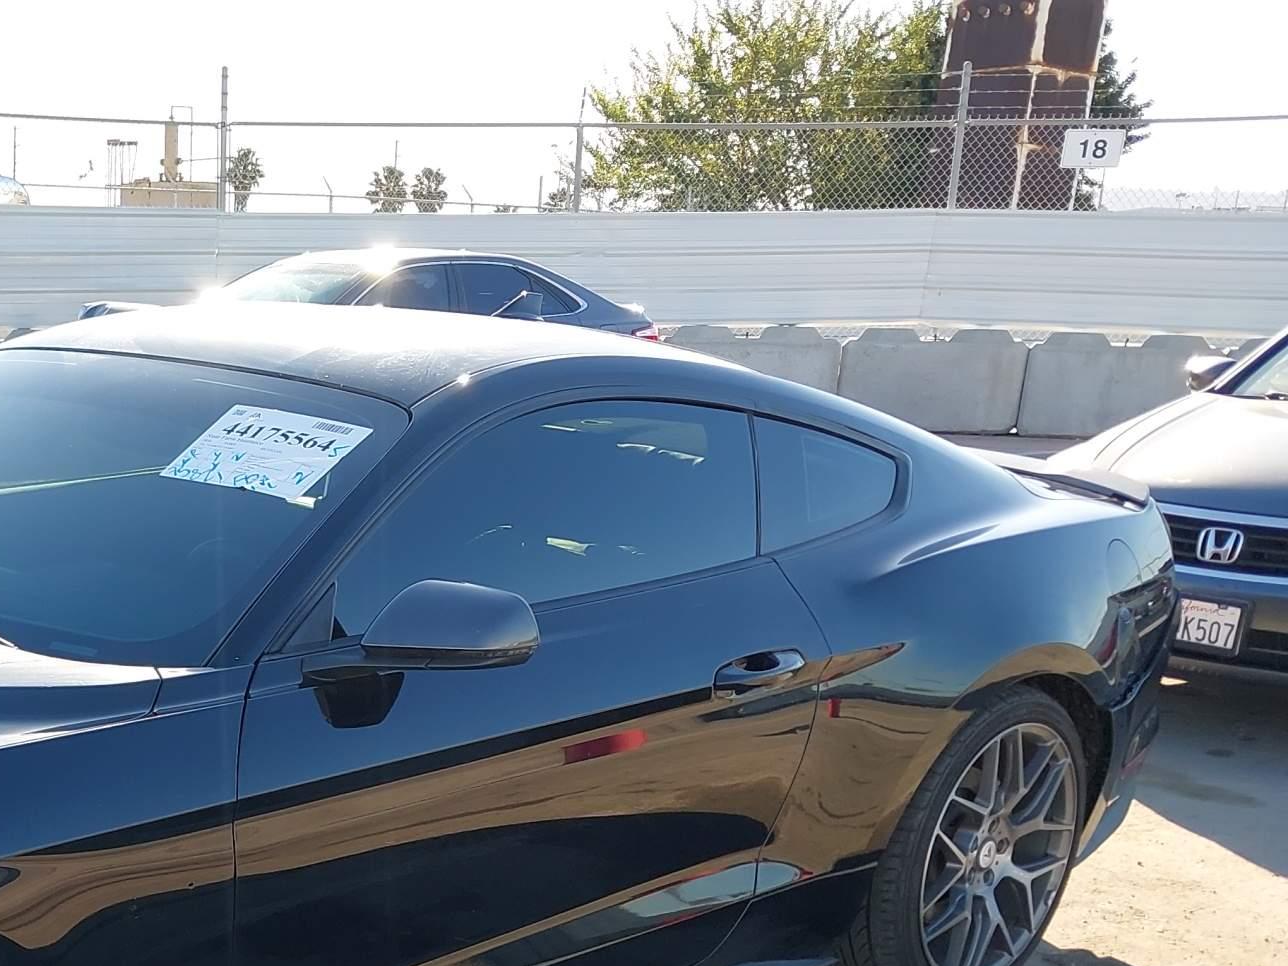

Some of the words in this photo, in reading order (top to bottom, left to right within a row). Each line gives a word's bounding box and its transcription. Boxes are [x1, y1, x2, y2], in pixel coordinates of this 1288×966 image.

[1079, 139, 1108, 159] 18
[222, 422, 337, 452] 44175564
[1181, 616, 1235, 648] K507
